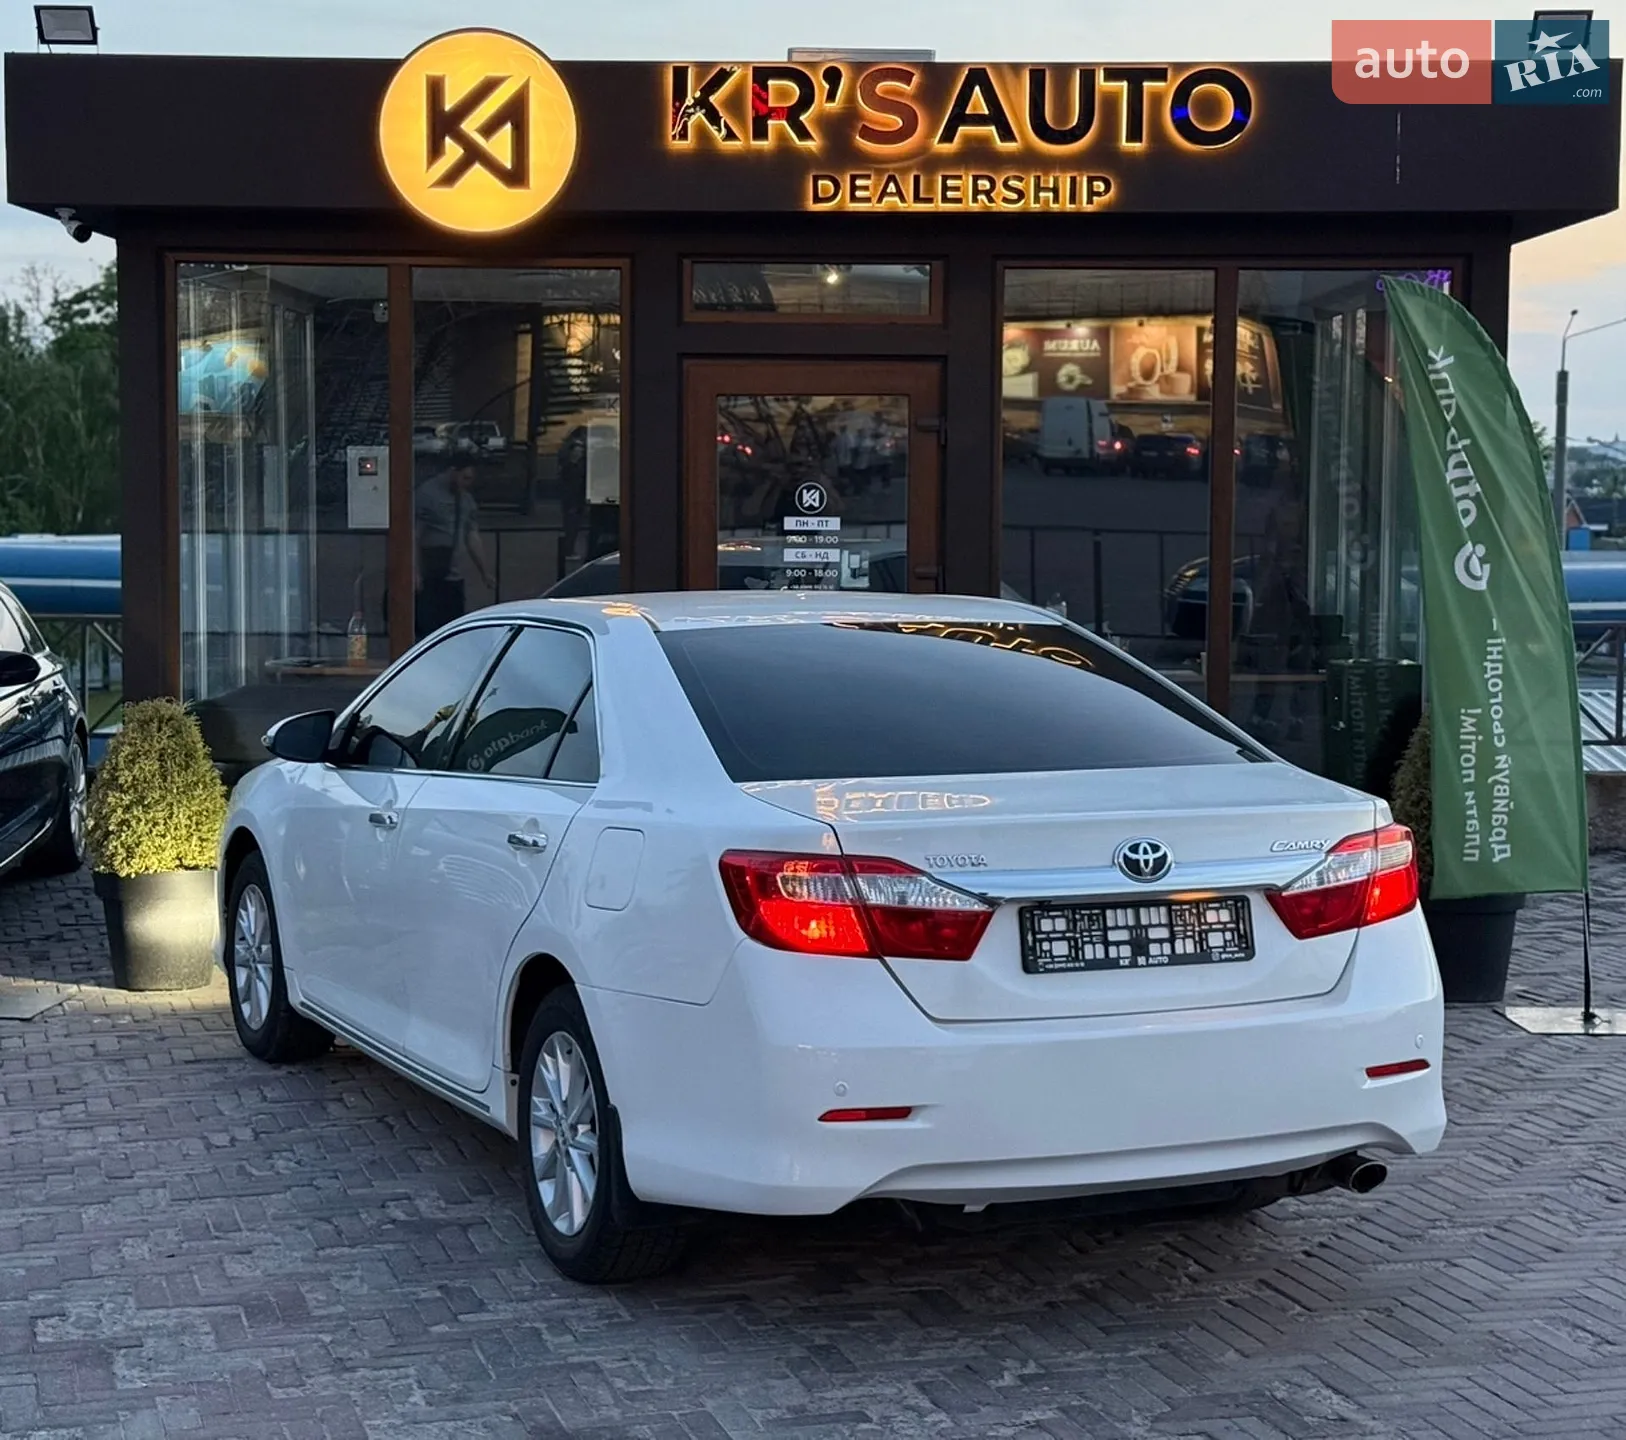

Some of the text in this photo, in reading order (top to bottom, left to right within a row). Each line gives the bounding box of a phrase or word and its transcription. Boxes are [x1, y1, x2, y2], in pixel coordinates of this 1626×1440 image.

[936, 66, 1253, 150] AUTO
[811, 173, 1114, 208] DEALERSHIP
[795, 519, 809, 528] ПН
[817, 519, 830, 528] ПТ
[795, 551, 807, 560] СБ
[815, 551, 830, 561] НД
[1270, 837, 1332, 853] CAMRY
[924, 854, 989, 868] TOYOTA
